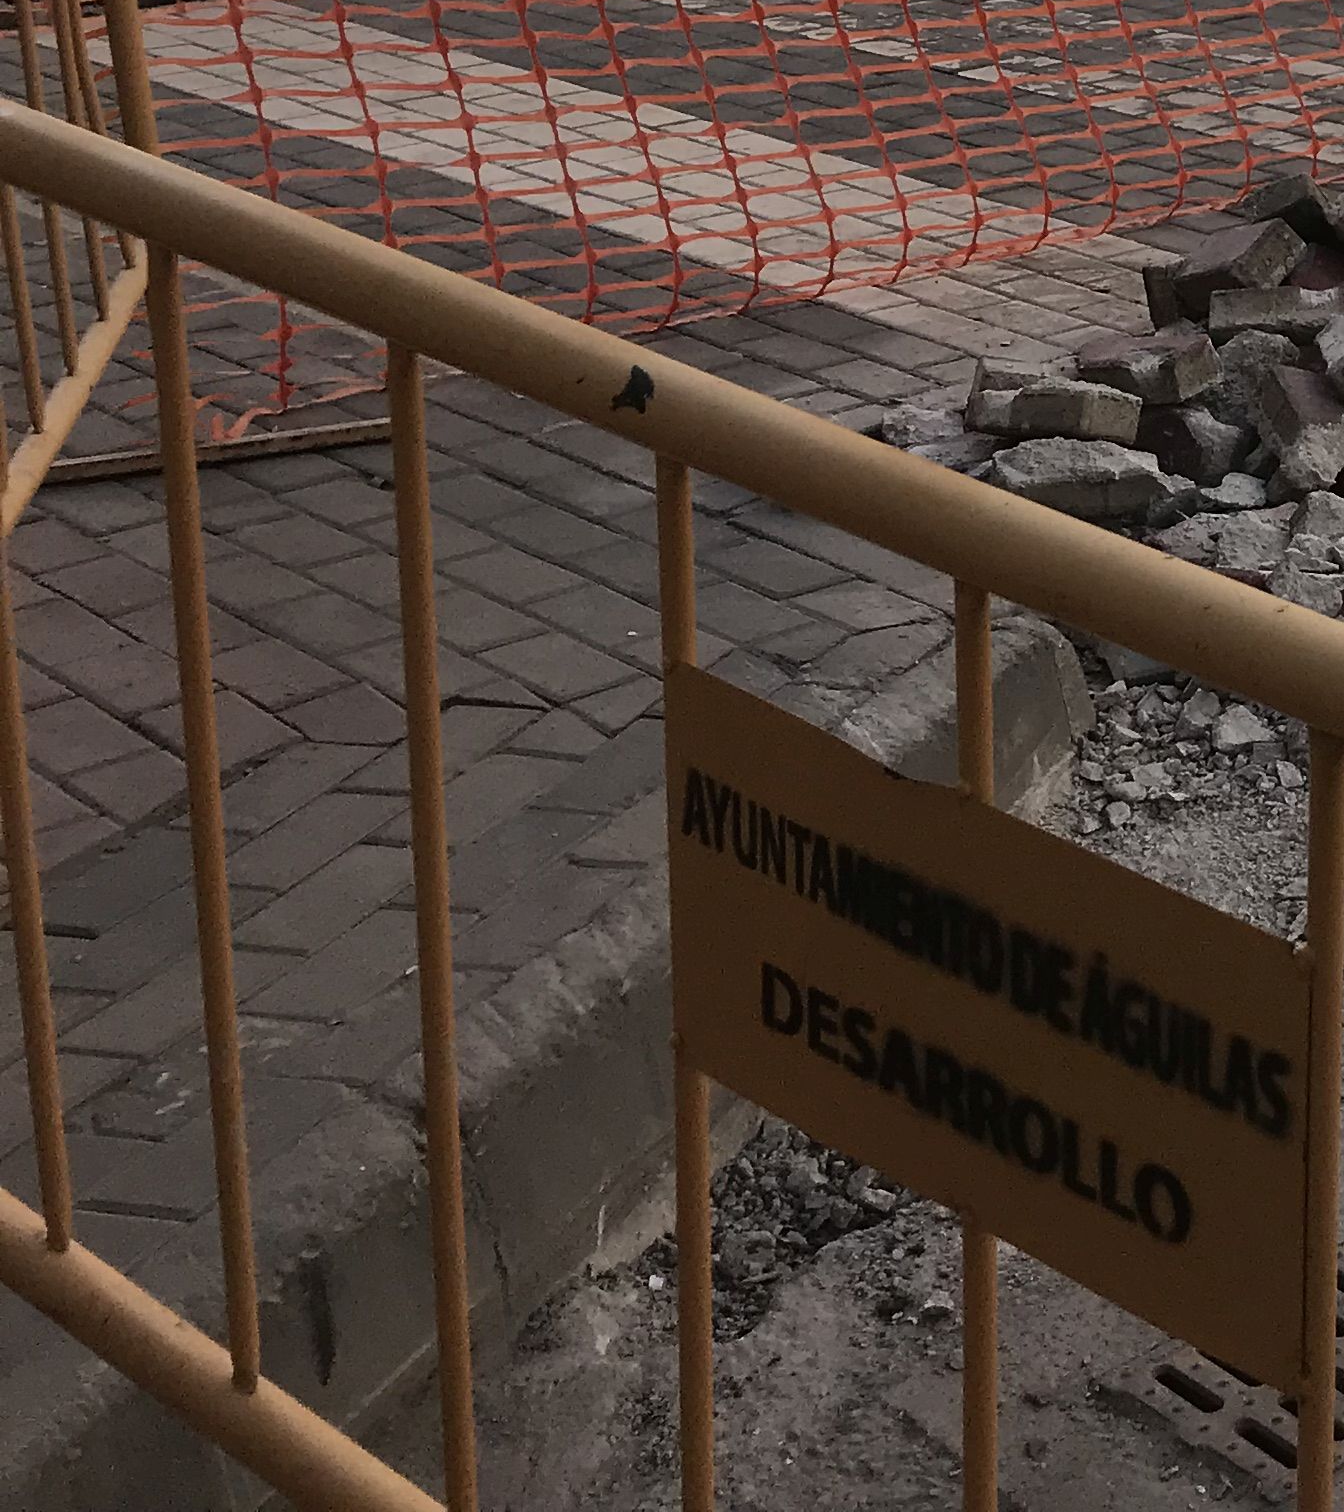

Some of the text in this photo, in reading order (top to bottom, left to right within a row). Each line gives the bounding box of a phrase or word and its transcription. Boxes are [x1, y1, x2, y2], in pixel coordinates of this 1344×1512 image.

[682, 767, 1004, 995] AYUNTAMIENTO
[1008, 924, 1077, 1034] DE
[759, 961, 1194, 1246] DESARROLLO
